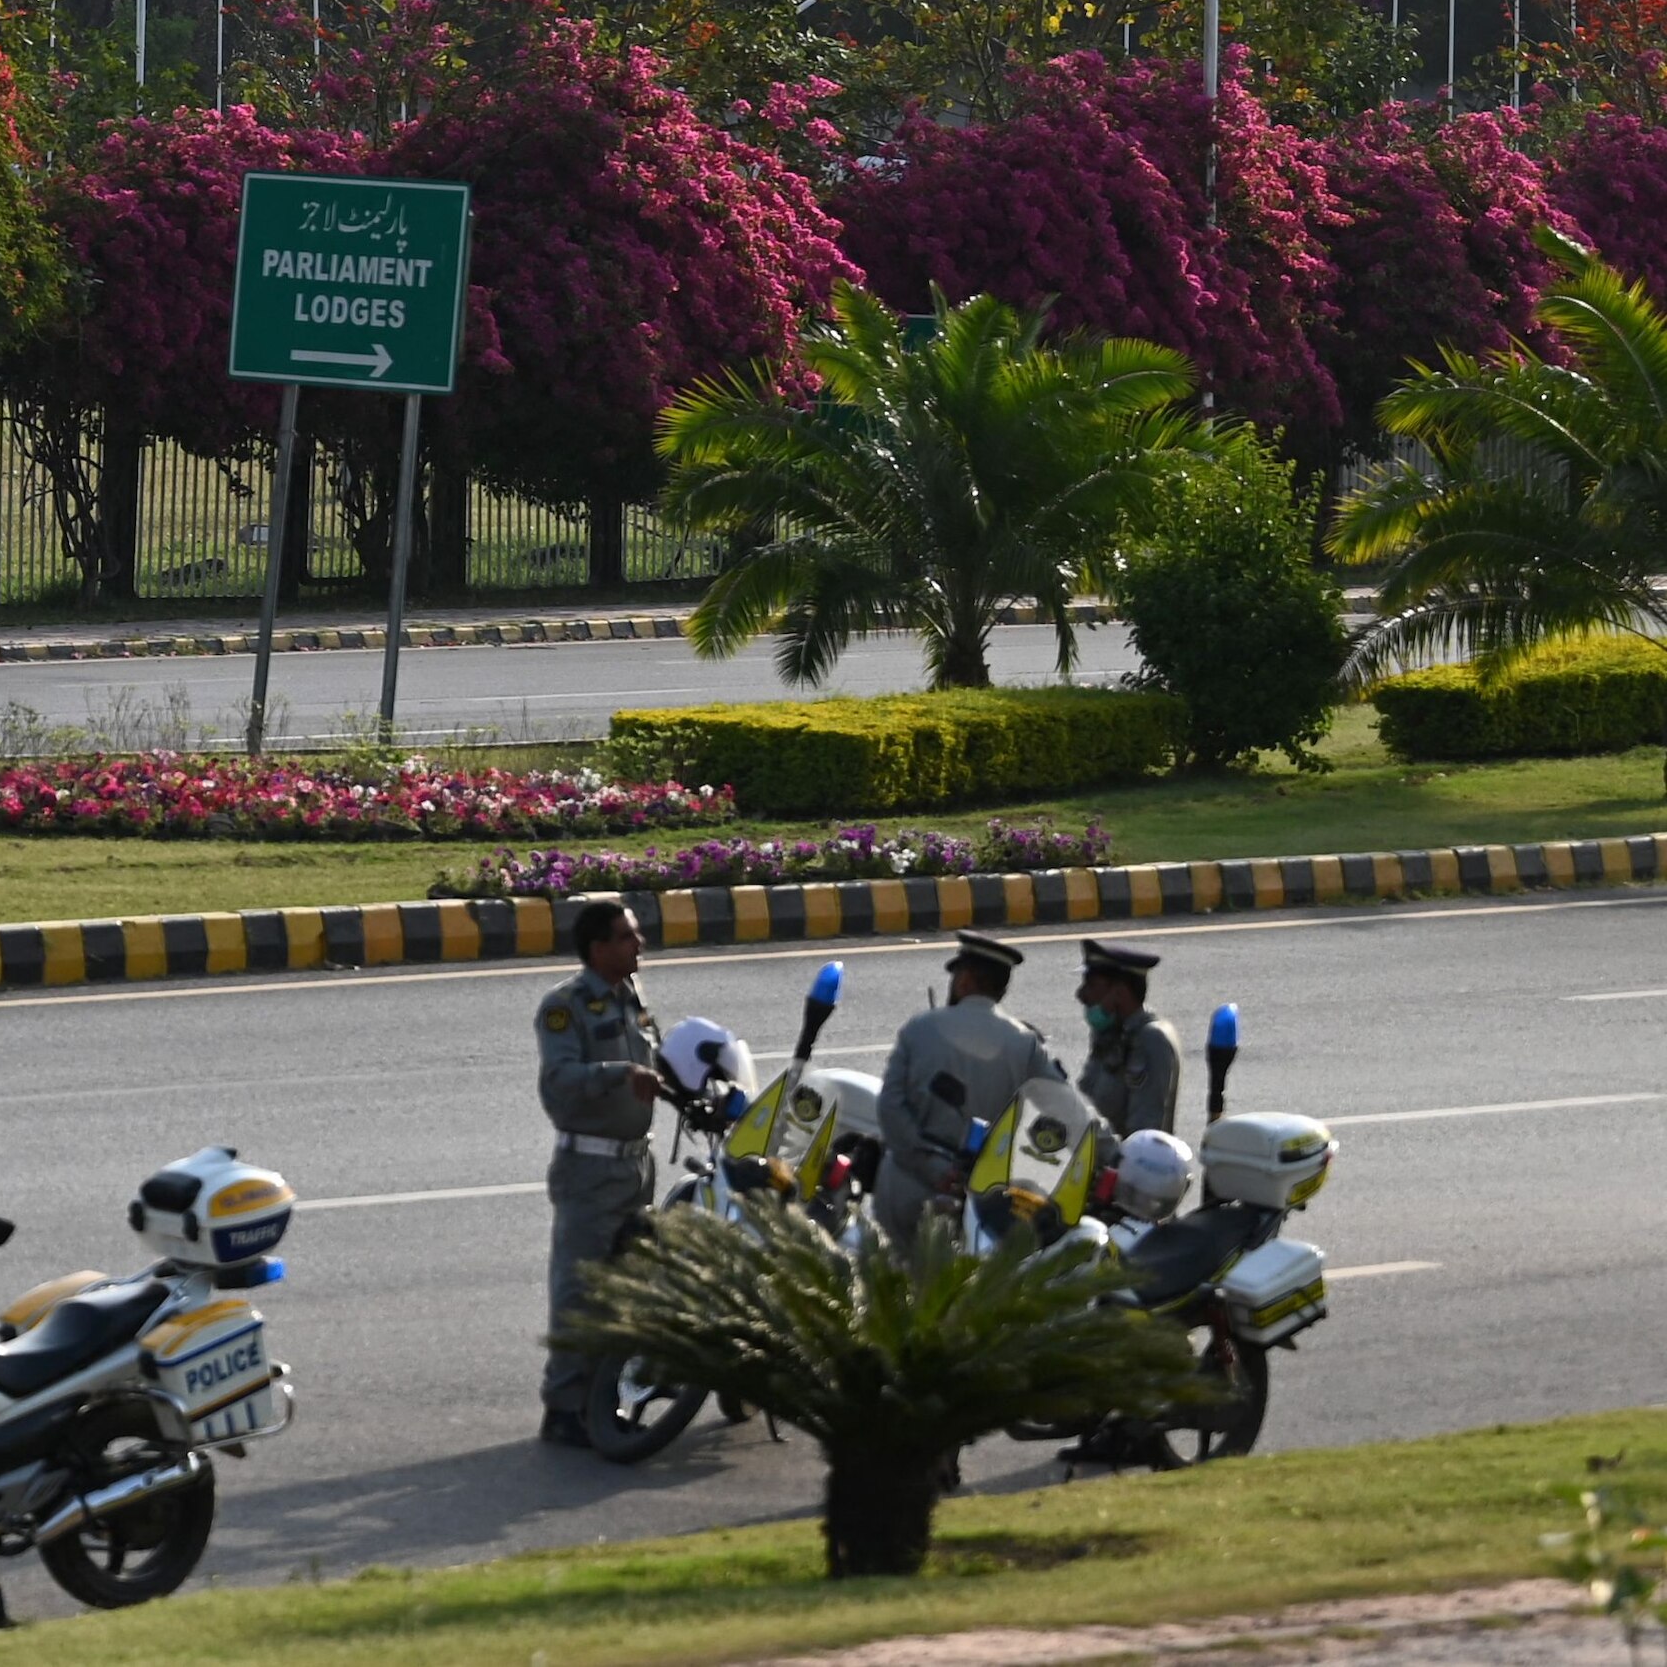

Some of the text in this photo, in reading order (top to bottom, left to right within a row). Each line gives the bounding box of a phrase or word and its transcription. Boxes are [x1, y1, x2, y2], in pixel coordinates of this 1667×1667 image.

[262, 248, 433, 288] PARLIAMENT
[294, 293, 406, 329] LODGES
[185, 1341, 260, 1394] POLICE
